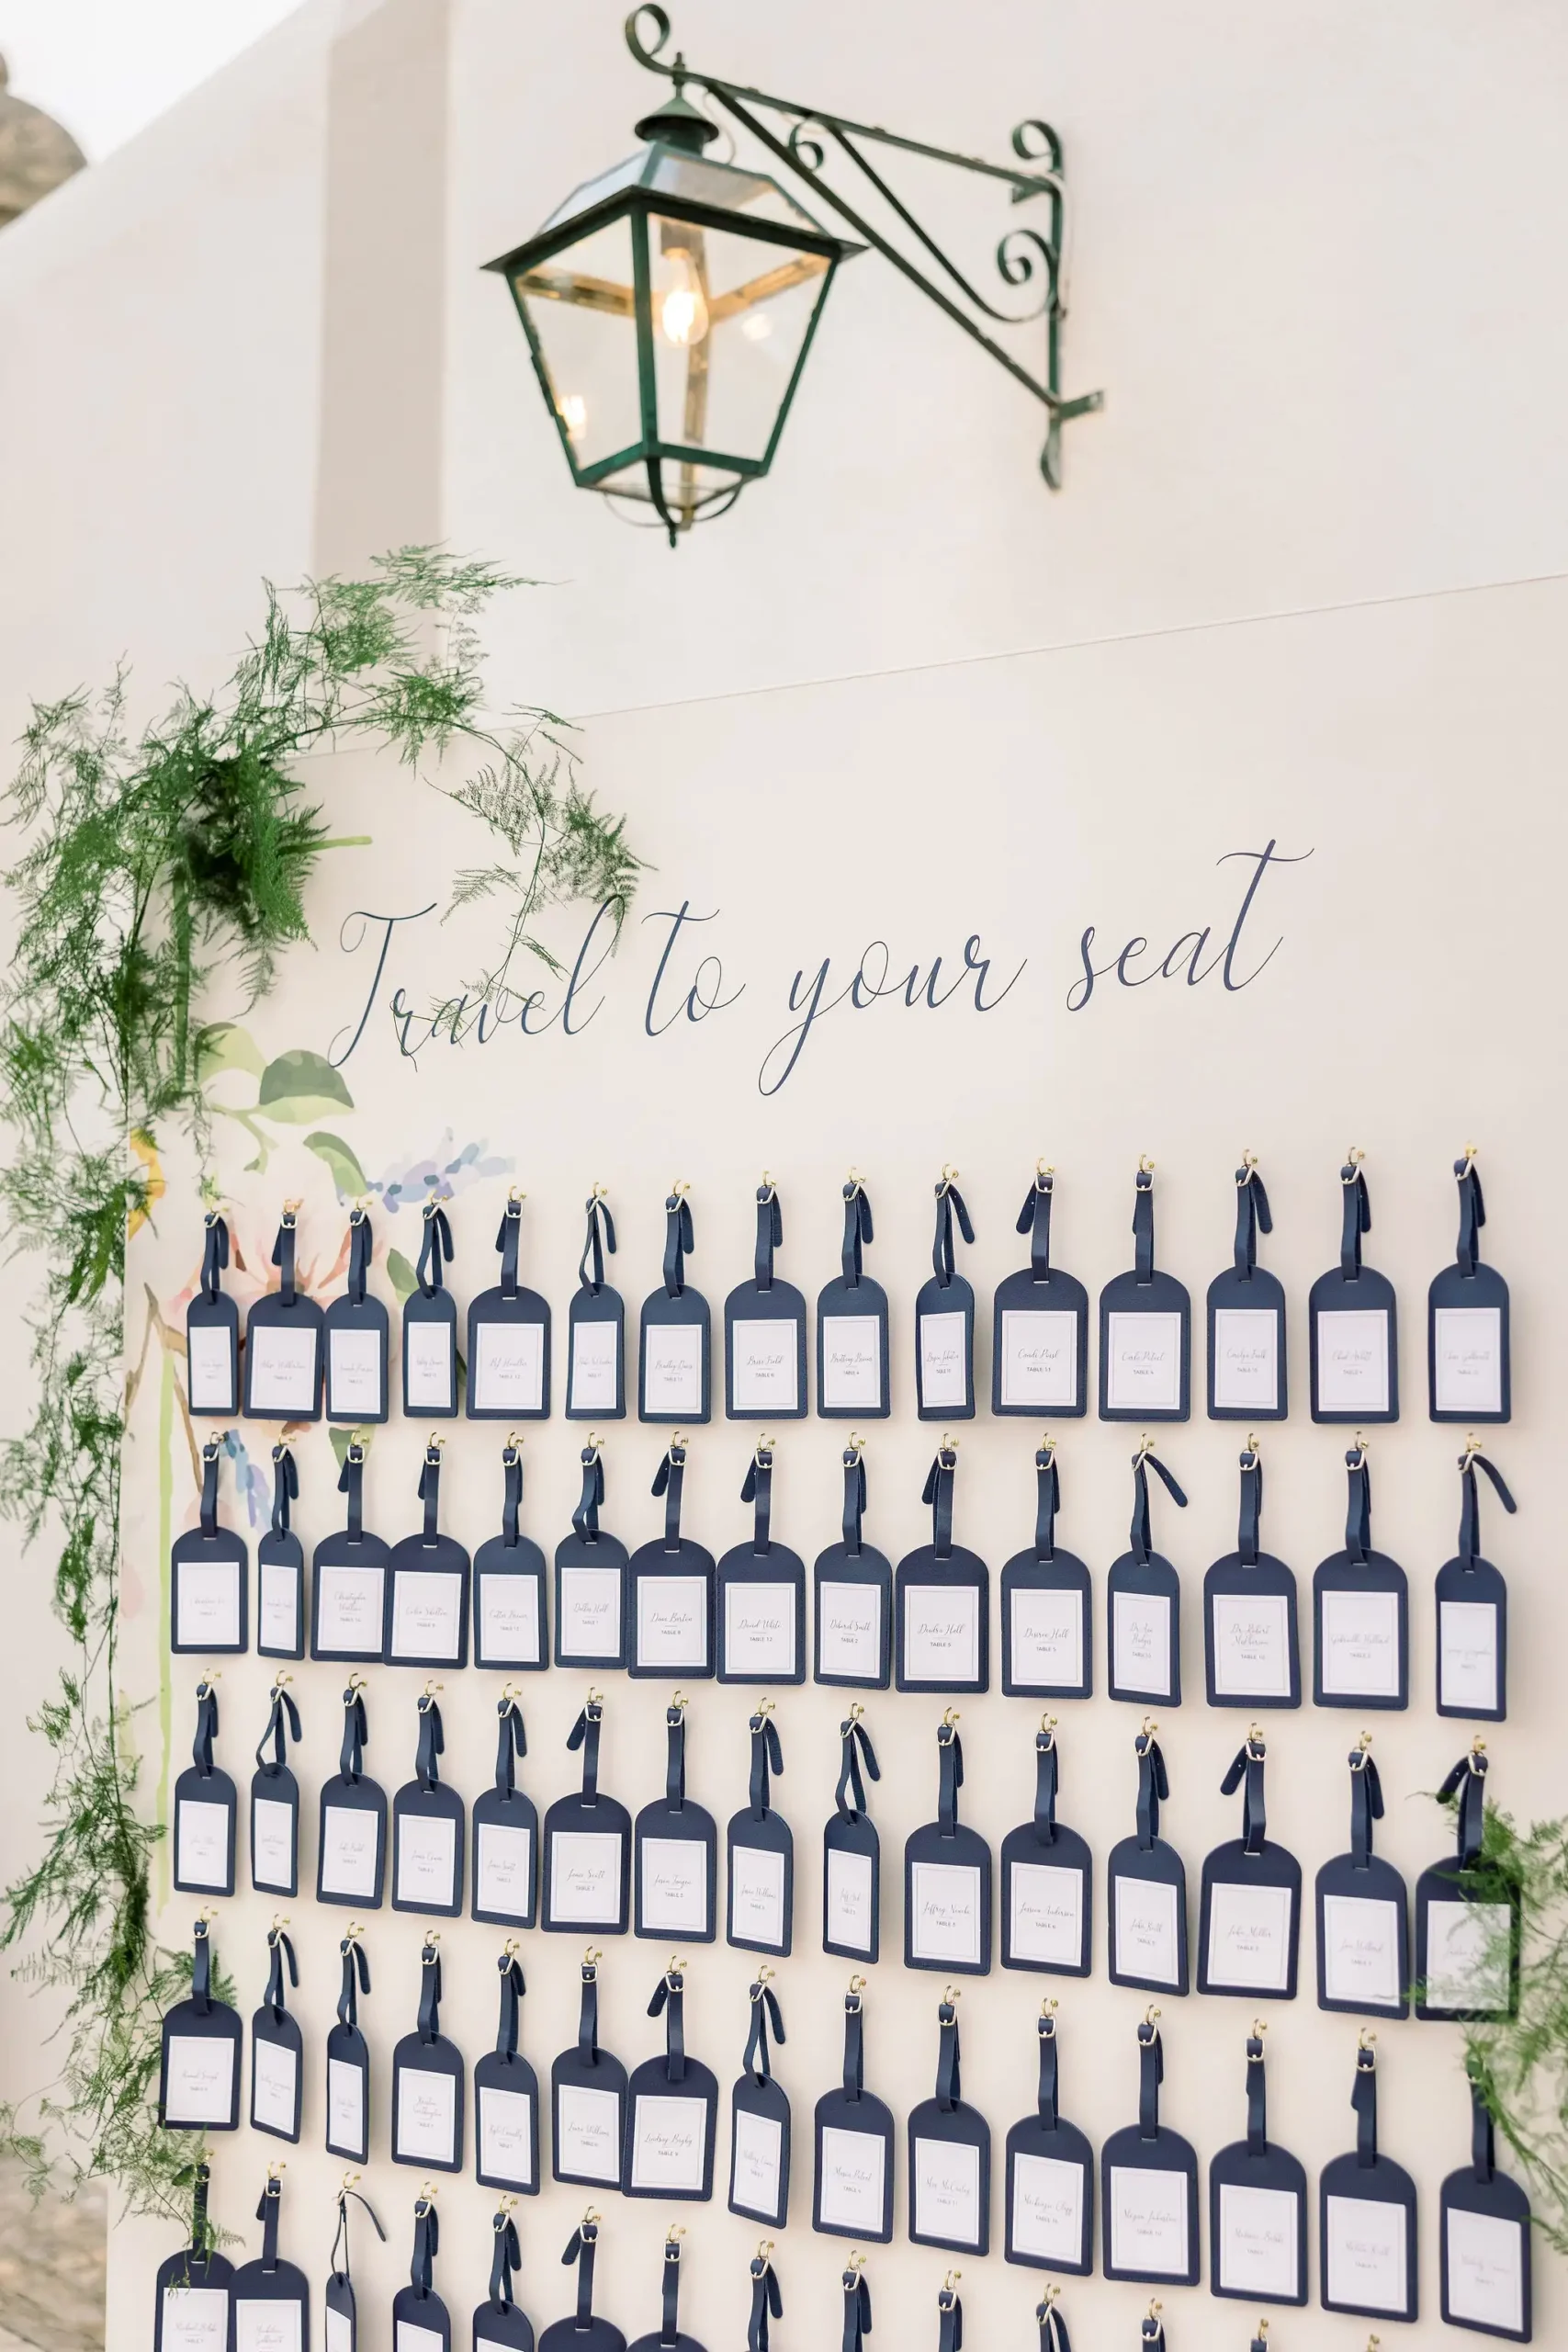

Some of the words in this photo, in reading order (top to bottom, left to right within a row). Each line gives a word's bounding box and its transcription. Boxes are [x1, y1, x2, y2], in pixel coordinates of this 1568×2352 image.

[328, 894, 625, 1068] Travel
[641, 900, 746, 1036] to
[759, 934, 1027, 1096] your
[1066, 839, 1315, 1012] seat
